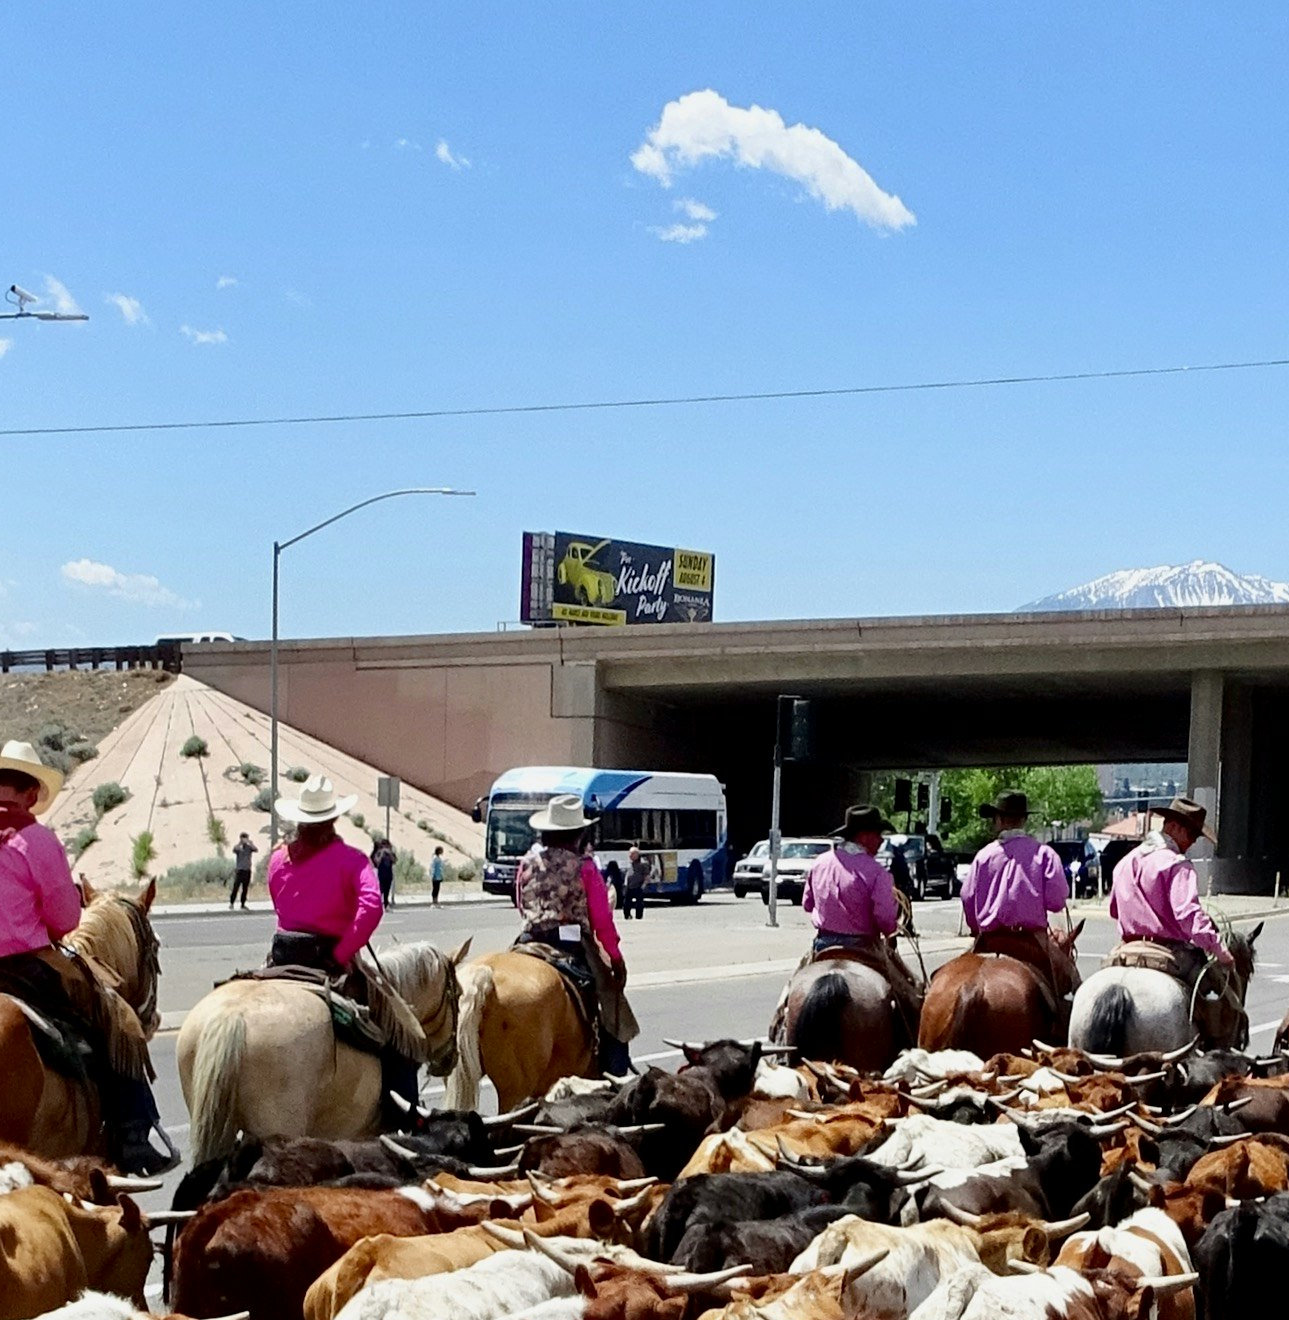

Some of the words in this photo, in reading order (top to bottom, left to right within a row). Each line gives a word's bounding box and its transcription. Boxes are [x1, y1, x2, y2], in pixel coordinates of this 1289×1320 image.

[679, 554, 709, 571] SUNDAY
[615, 560, 672, 596] Kickoff
[679, 571, 700, 585] AUGUST
[636, 595, 668, 621] Party
